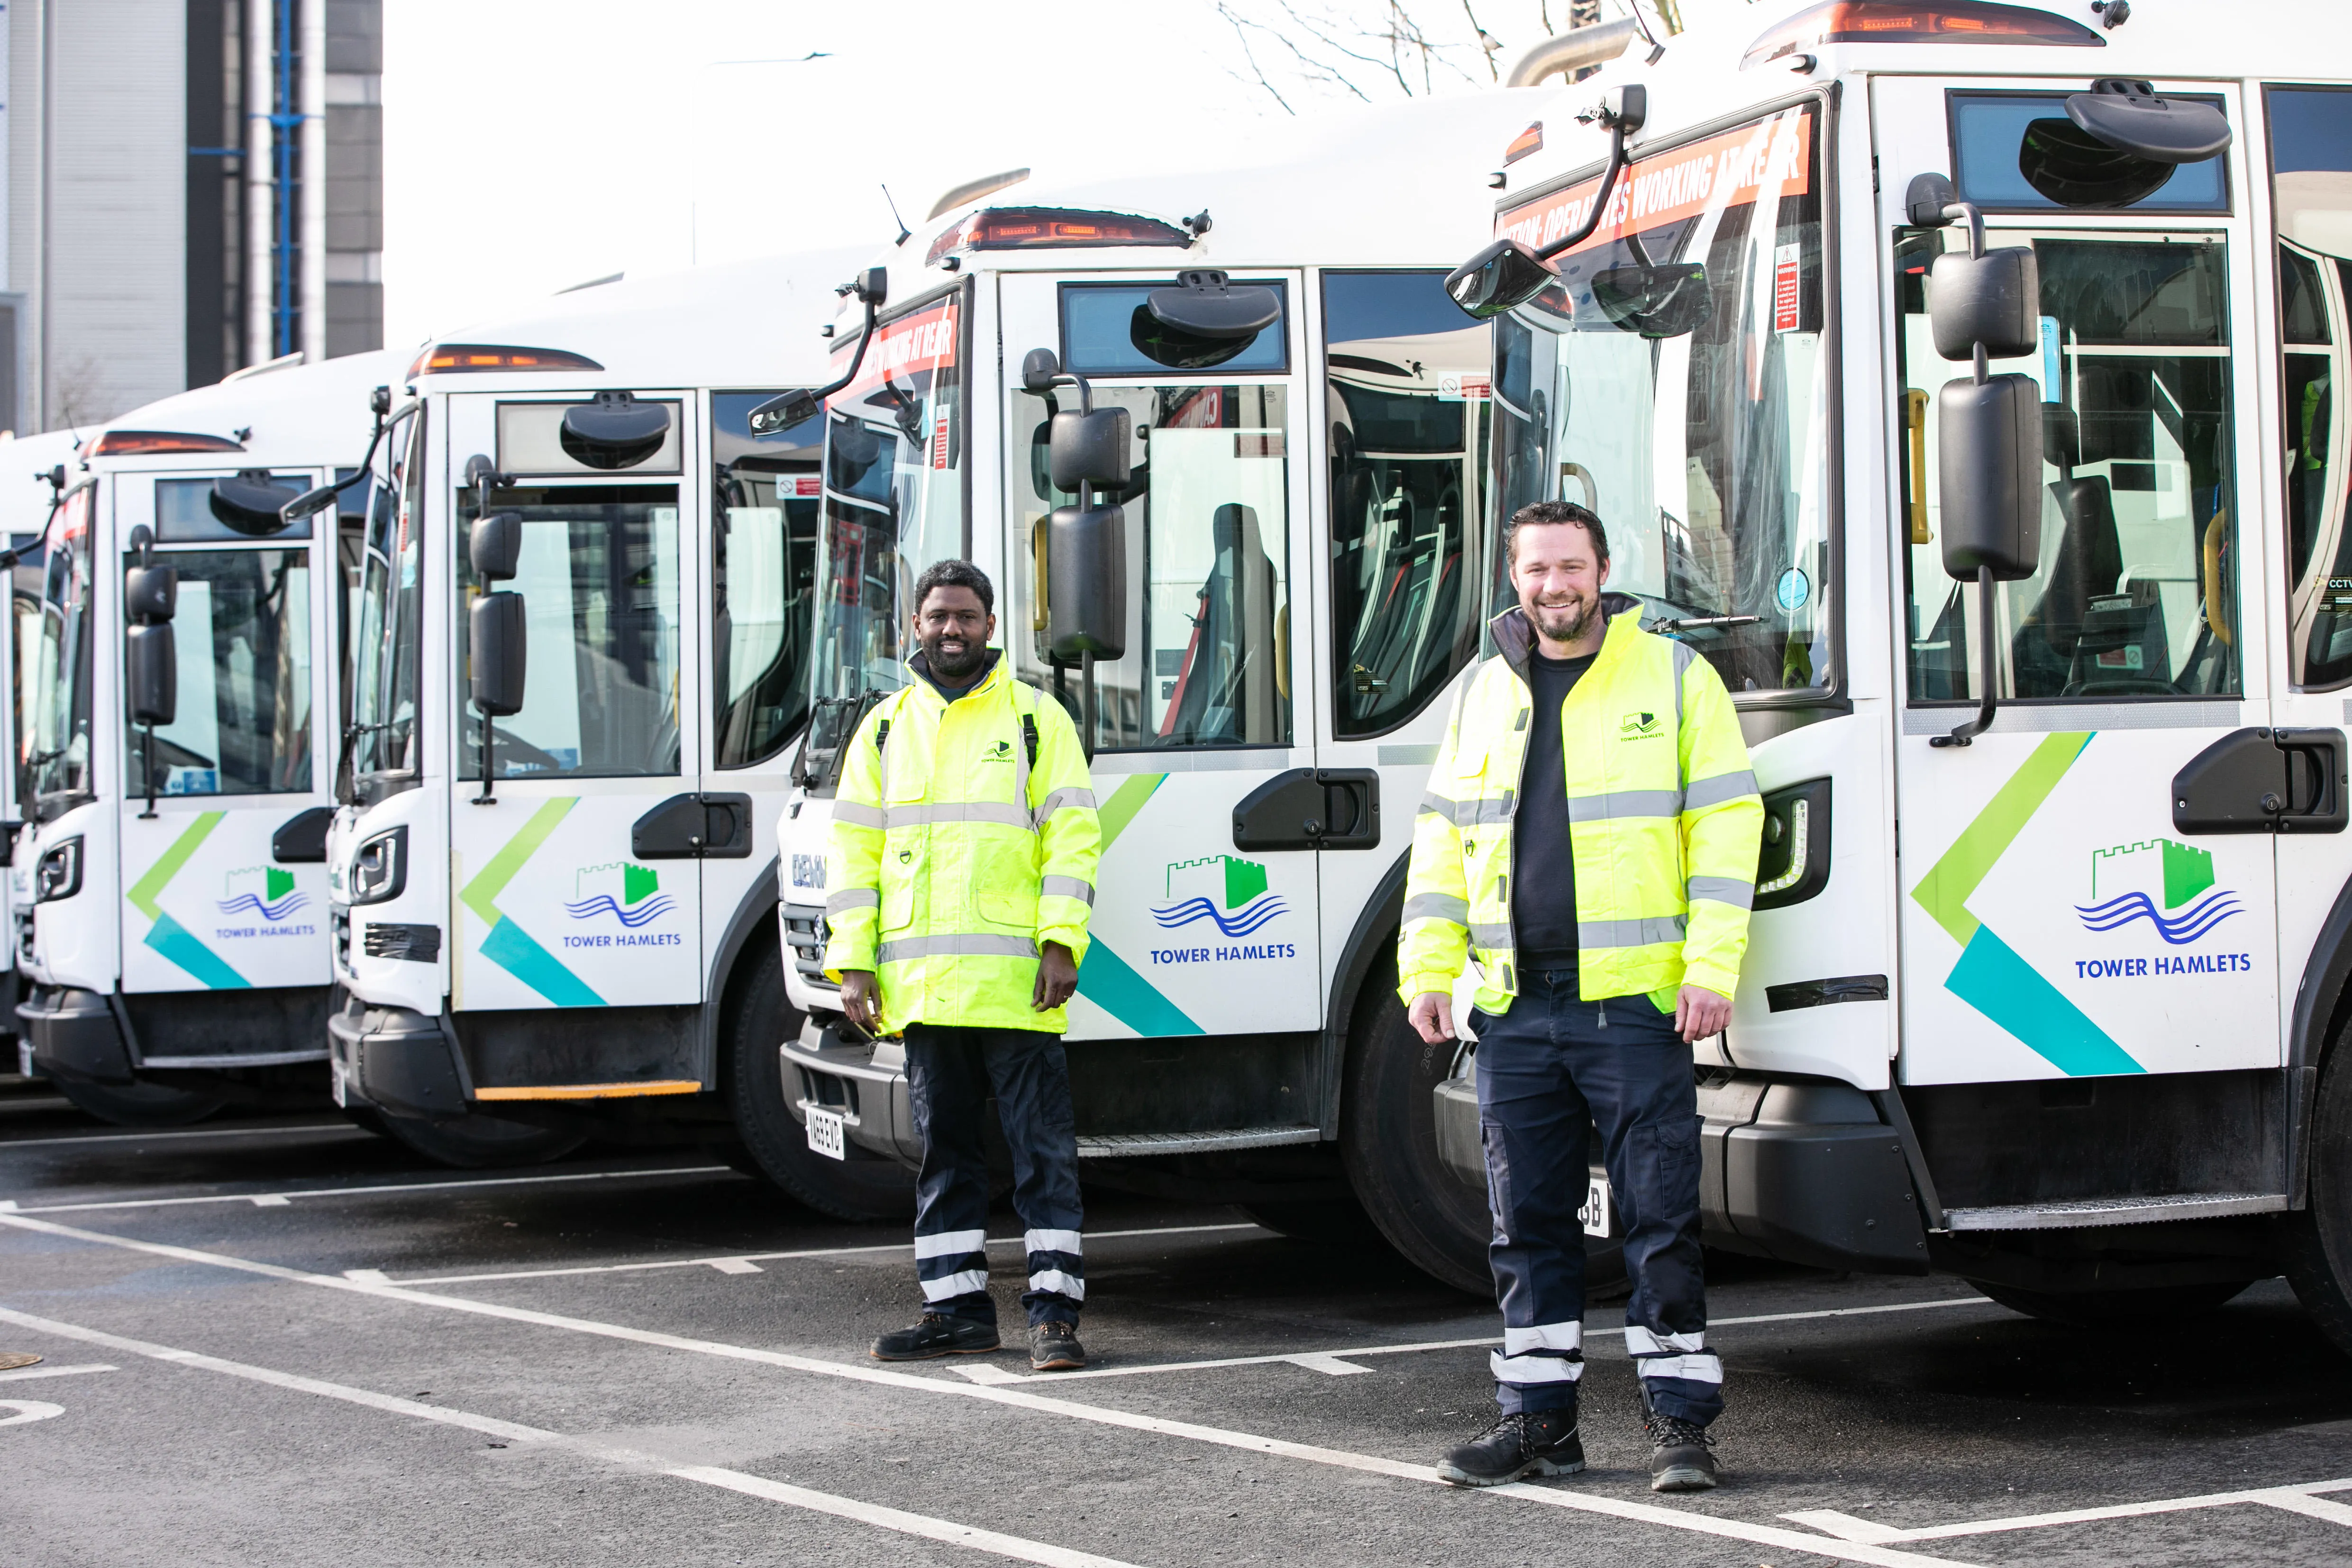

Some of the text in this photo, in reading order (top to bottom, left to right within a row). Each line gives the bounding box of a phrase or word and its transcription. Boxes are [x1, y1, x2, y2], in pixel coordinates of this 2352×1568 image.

[1632, 154, 1713, 220] WORKING
[1712, 146, 1741, 194] AT
[1739, 133, 1799, 188] REAR
[1778, 265, 1796, 274] WARNING
[910, 326, 924, 362] AT
[922, 319, 952, 358] REAR
[216, 925, 316, 938] TOWER HAMLETS
[563, 933, 681, 947] TOWER HAMLETS
[1151, 944, 1295, 964] TOWER HAMLETS
[2075, 953, 2251, 978] TOWER HAMLETS
[825, 1118, 841, 1151] EYD
